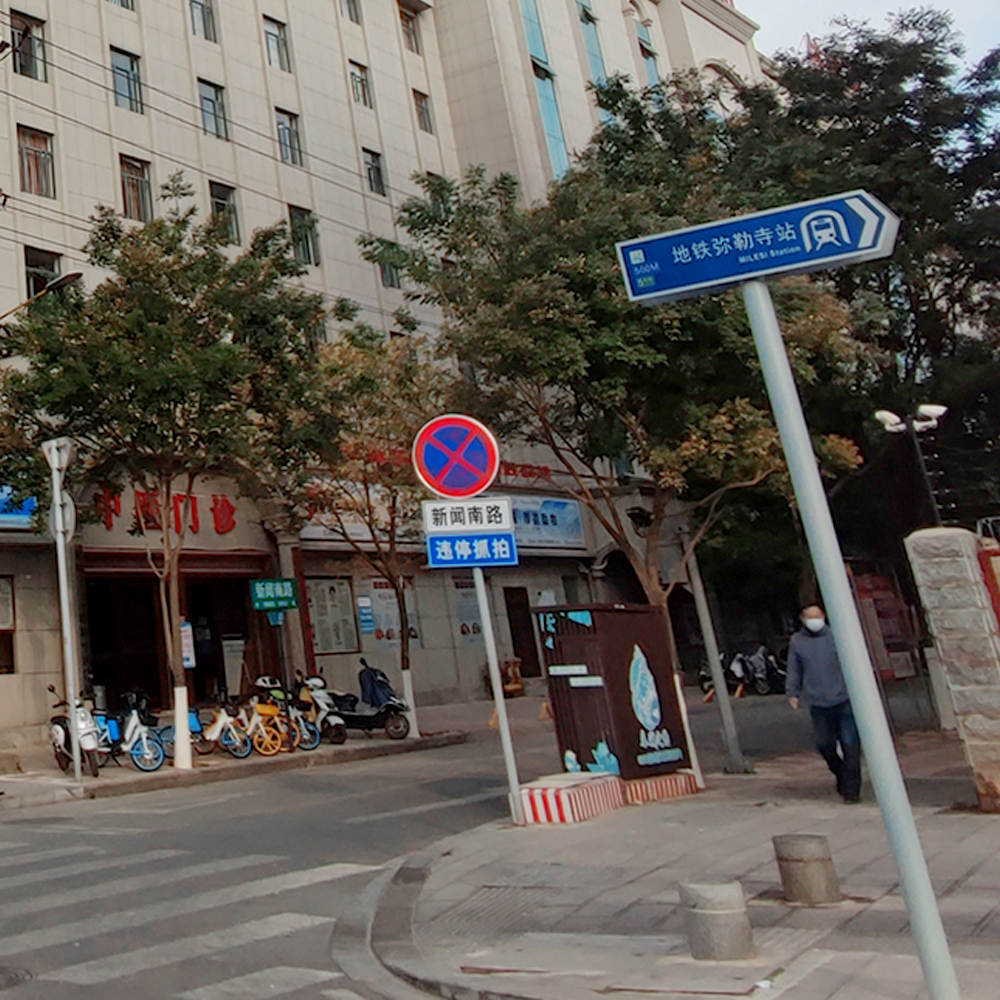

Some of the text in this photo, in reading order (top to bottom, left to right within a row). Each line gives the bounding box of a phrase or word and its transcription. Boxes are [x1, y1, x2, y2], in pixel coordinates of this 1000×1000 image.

[671, 220, 797, 265] 地铁弥勒寺站
[769, 246, 802, 258] Station
[431, 505, 504, 527] 新闻南路
[435, 538, 511, 560] 违停抓拍
